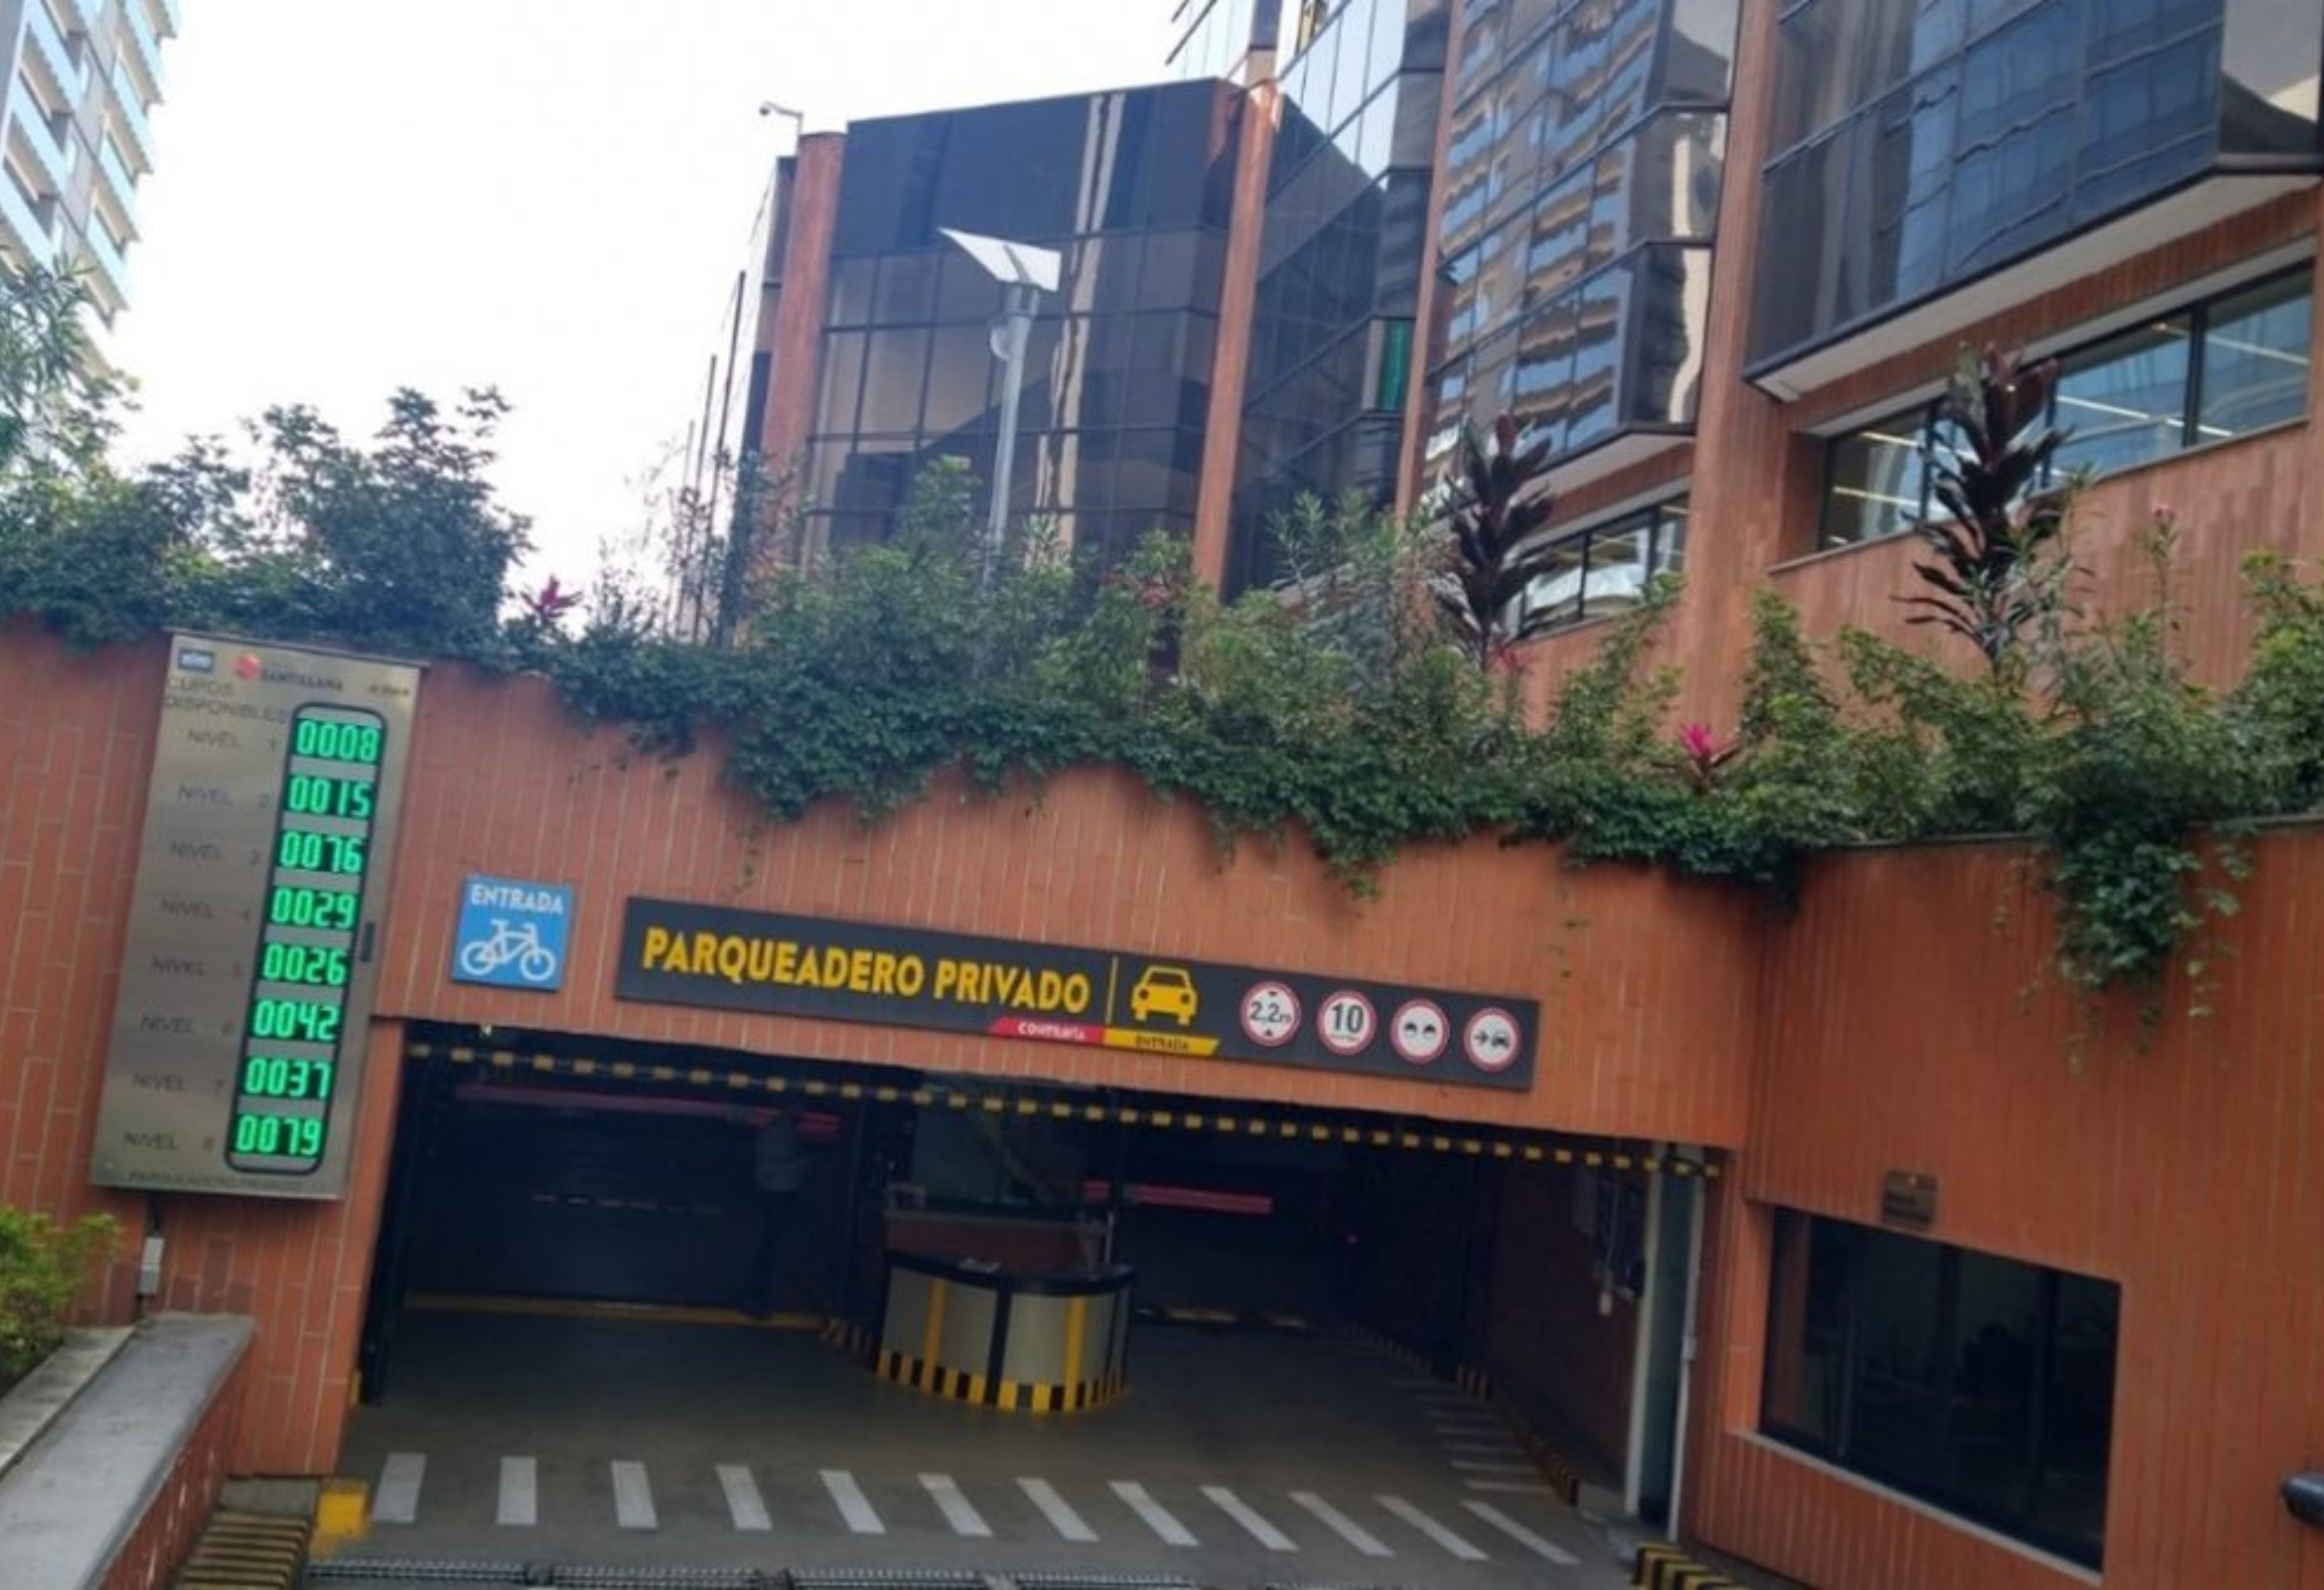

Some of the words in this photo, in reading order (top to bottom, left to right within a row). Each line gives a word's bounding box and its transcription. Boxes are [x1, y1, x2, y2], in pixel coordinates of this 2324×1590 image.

[189, 729, 240, 749] NIVEL
[297, 720, 379, 762] 0008
[178, 785, 233, 806] NIVEL
[290, 775, 370, 816] 0015
[172, 843, 225, 861] NIVEL
[281, 831, 361, 873] 0076
[161, 899, 214, 919] NIVEL
[271, 888, 355, 928] 0029
[469, 883, 564, 915] ENTRADA
[153, 956, 208, 977] NIVEL
[264, 943, 345, 985] 0026
[643, 926, 924, 997] PARQUEADERO
[934, 959, 1089, 1013] PRIVADO
[140, 1015, 194, 1034] NIVEL
[254, 1000, 339, 1040] 0042
[1332, 1002, 1364, 1033] 10
[133, 1074, 188, 1091] NIVEL
[246, 1058, 330, 1098] 0037
[123, 1132, 179, 1151] NIVEL
[237, 1115, 321, 1155] 0079
